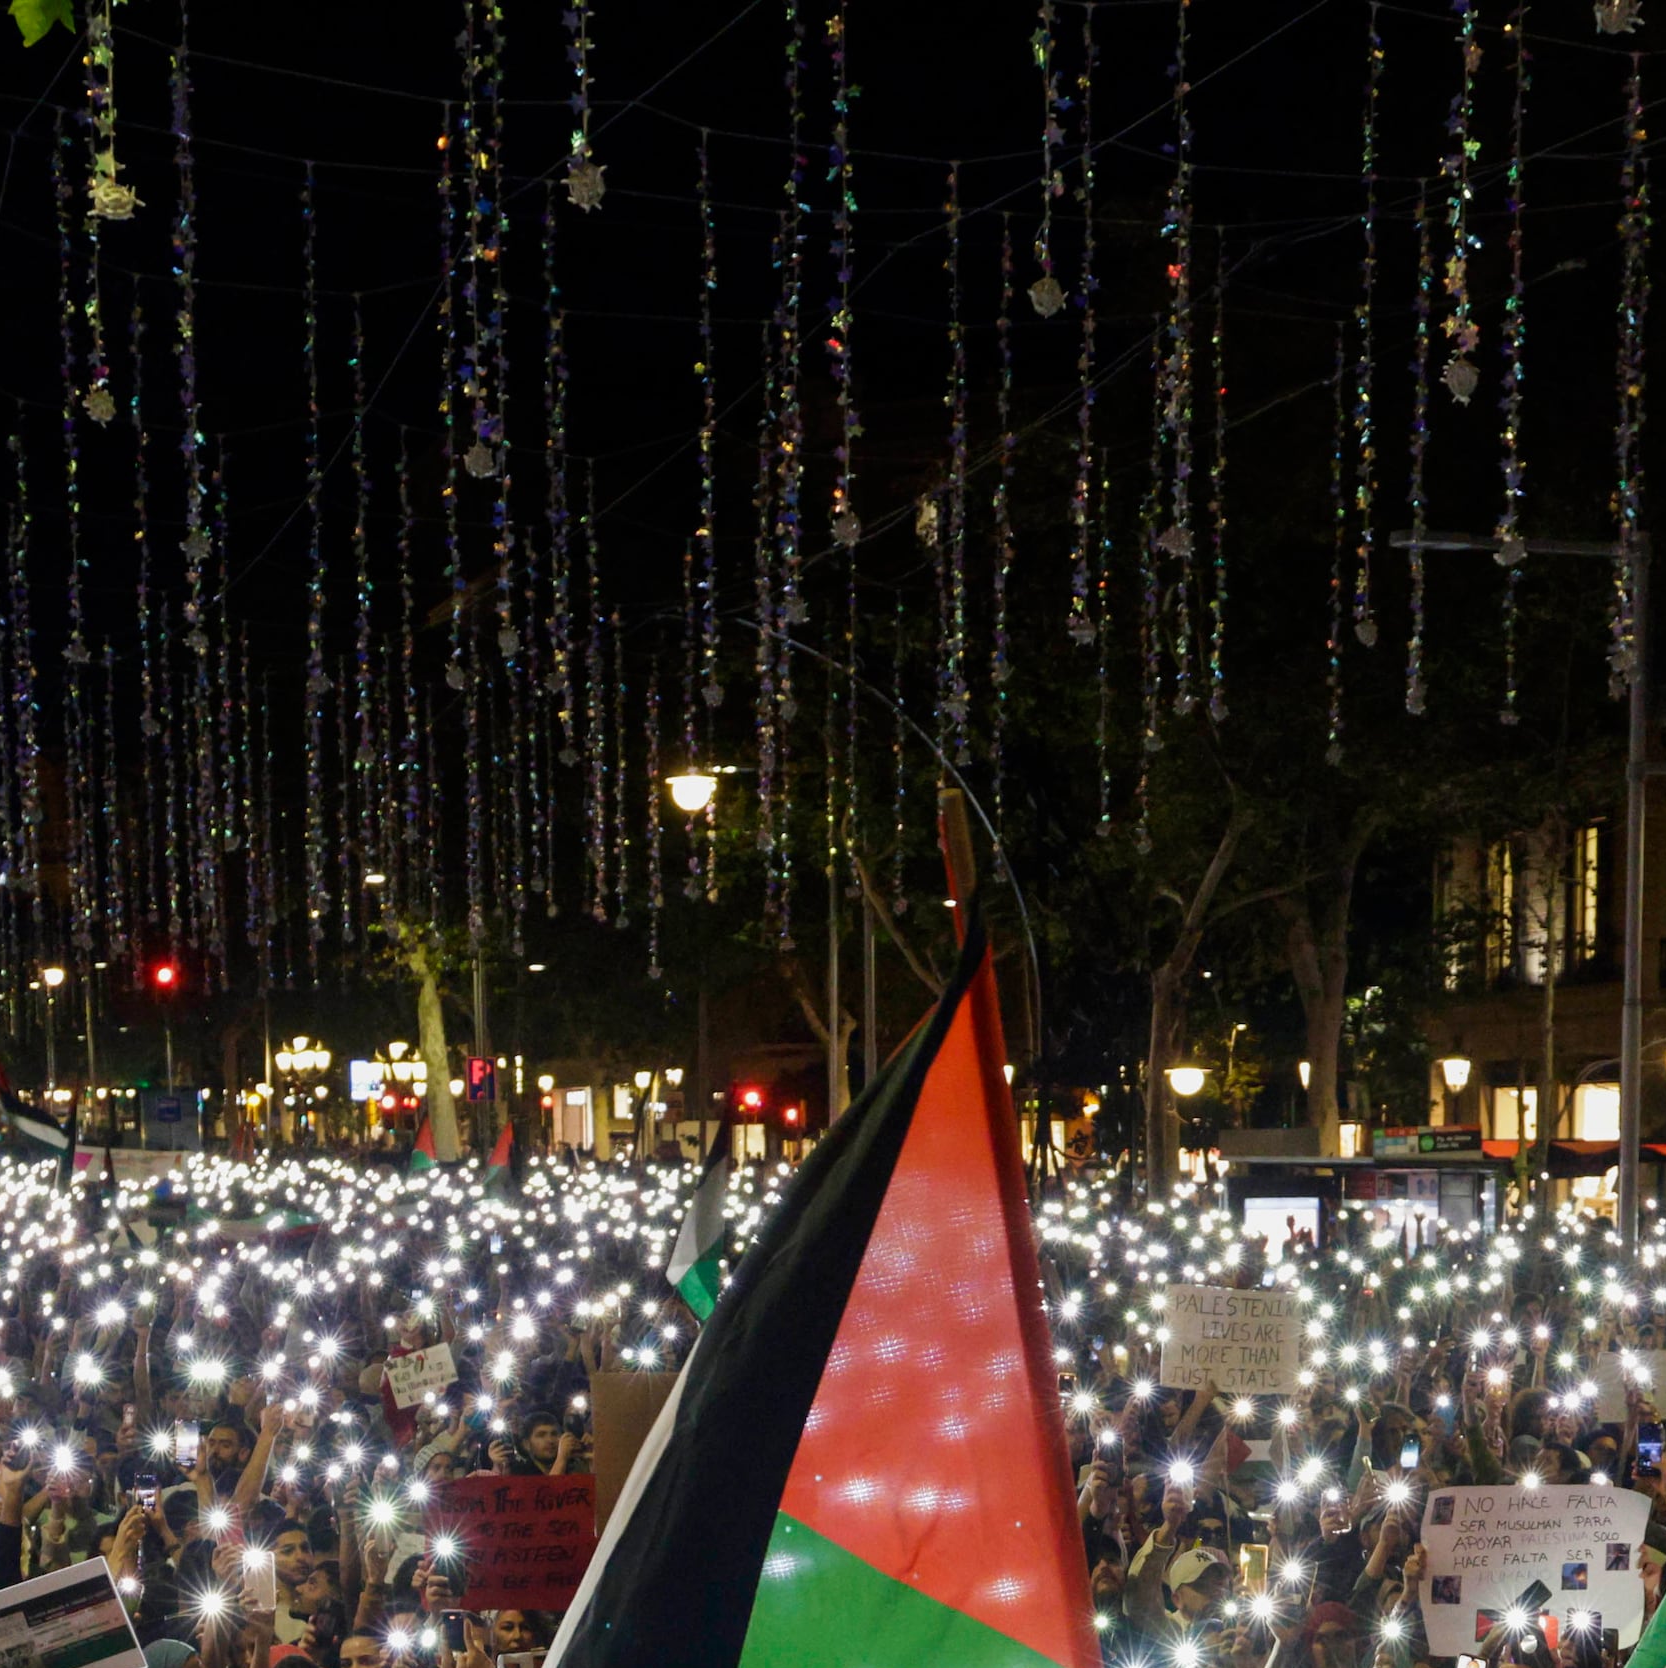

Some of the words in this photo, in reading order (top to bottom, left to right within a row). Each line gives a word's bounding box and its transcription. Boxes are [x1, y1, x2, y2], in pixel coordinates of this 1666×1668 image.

[1254, 1324, 1285, 1344] ARE
[1239, 1346, 1280, 1366] THAN
[1464, 1496, 1494, 1516] NO
[1508, 1496, 1552, 1512] HACE
[1566, 1494, 1618, 1510] FALTA
[1456, 1520, 1486, 1533] SER
[1573, 1515, 1613, 1528] PARA
[1452, 1535, 1511, 1551] APOYAR
[1593, 1532, 1620, 1543] SOLO
[1453, 1556, 1489, 1568] HACE
[1503, 1552, 1548, 1566] FALTA
[1567, 1549, 1595, 1561] SER
